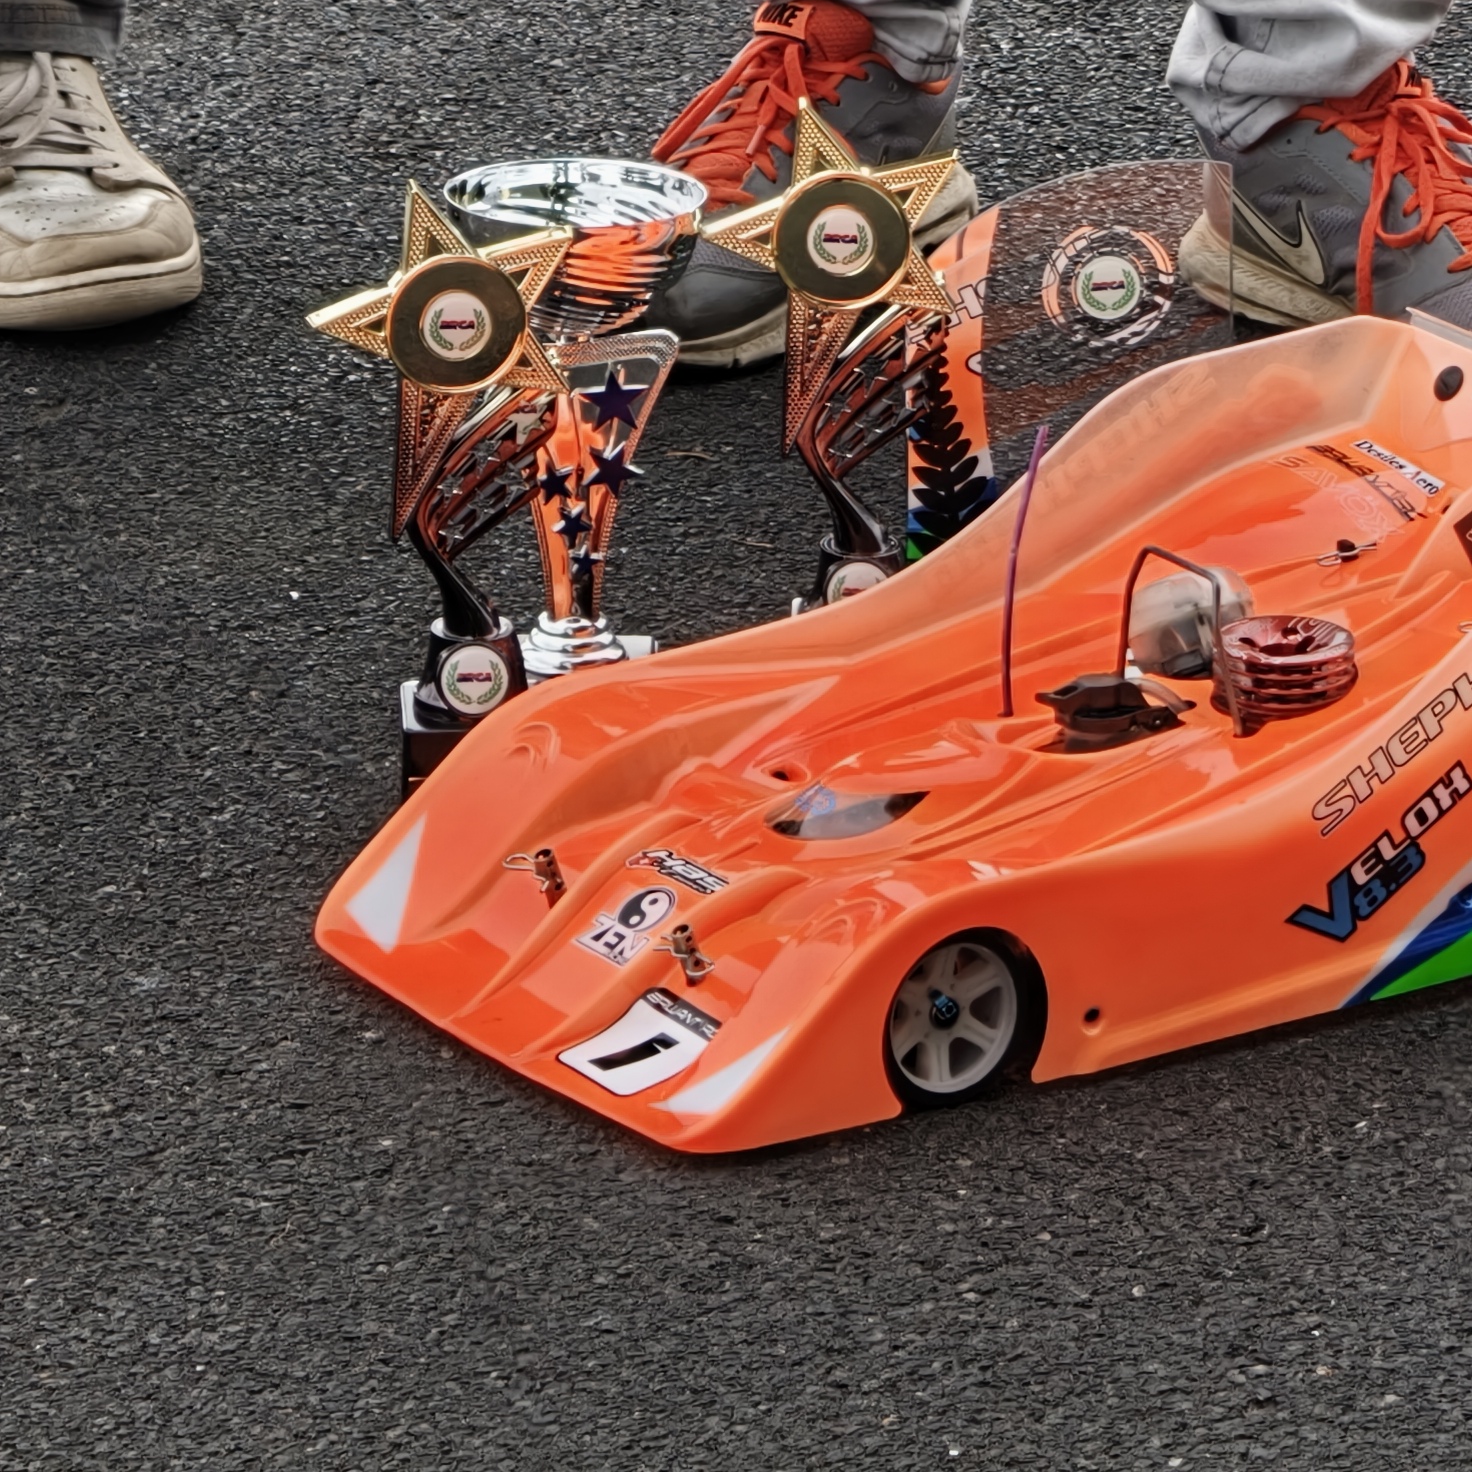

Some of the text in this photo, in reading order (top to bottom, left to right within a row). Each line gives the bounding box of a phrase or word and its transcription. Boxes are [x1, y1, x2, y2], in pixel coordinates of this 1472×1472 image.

[757, 3, 804, 28] NIKE
[1354, 843, 1426, 921] 8.3
[574, 913, 650, 967] ZEN
